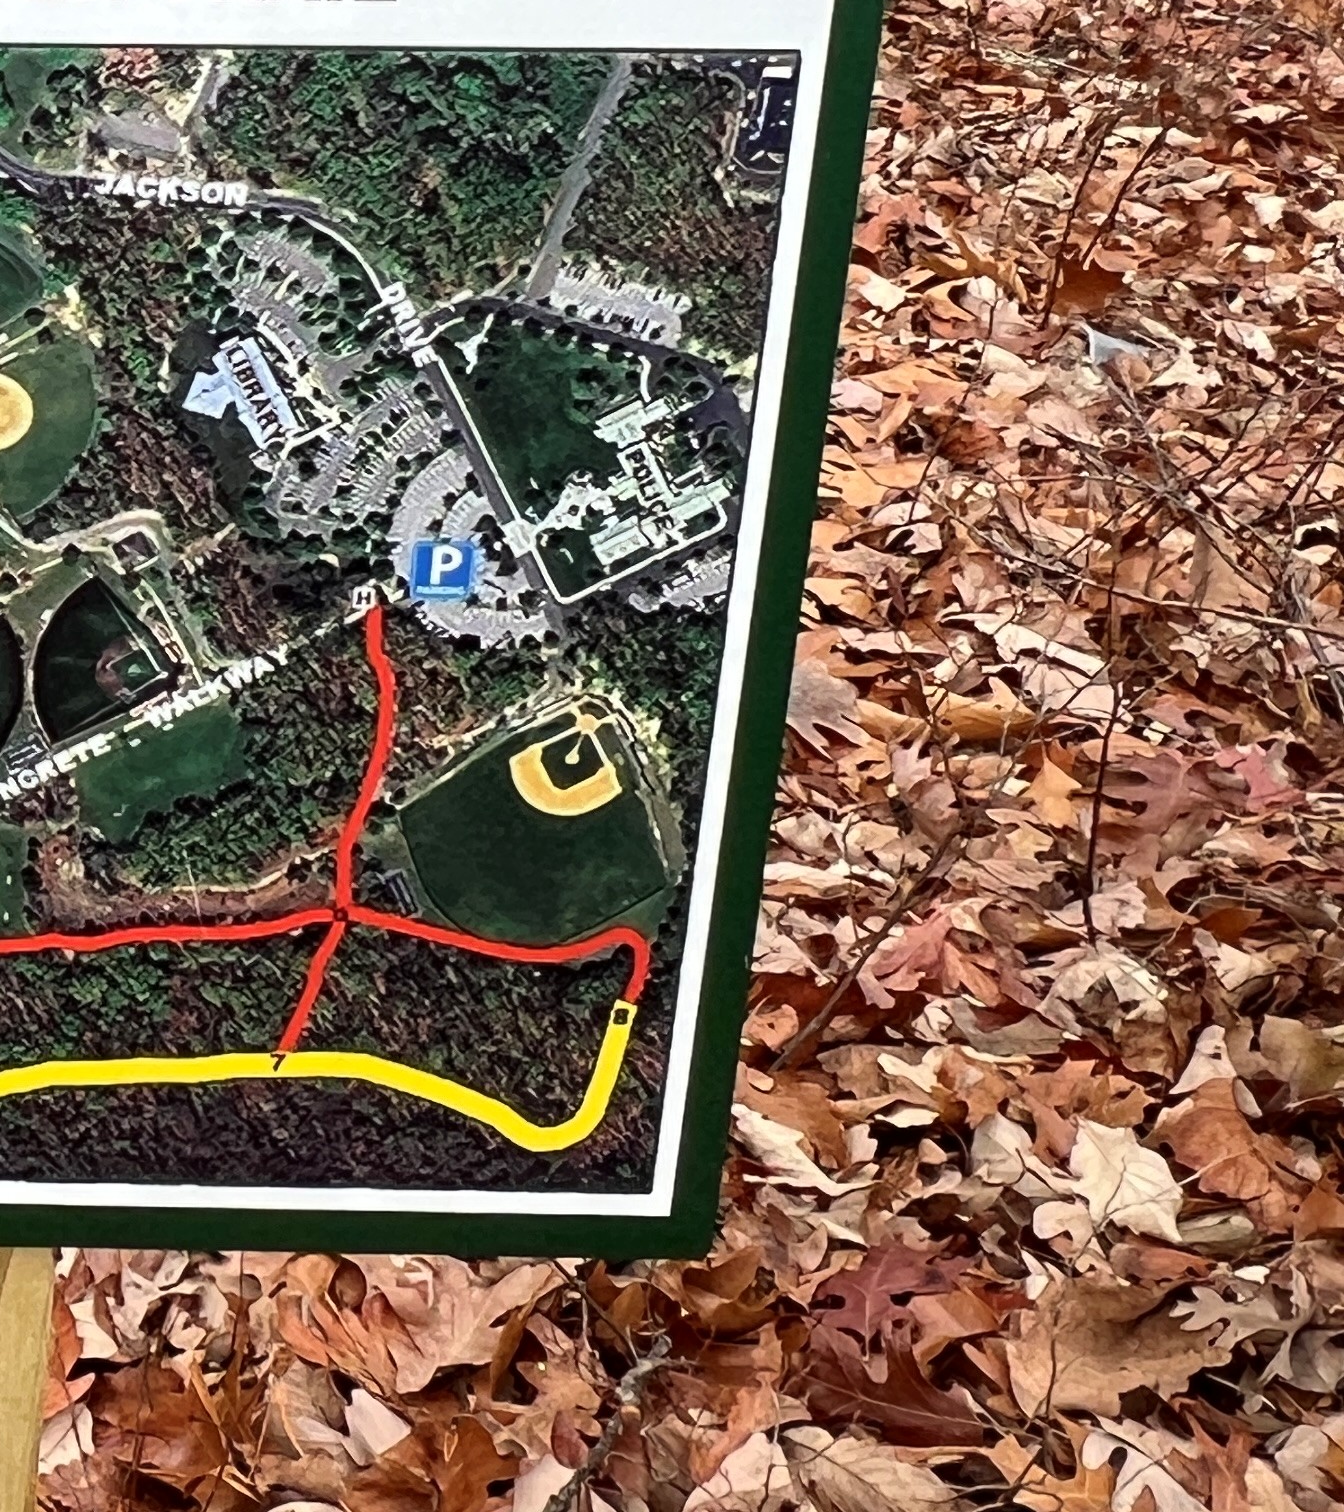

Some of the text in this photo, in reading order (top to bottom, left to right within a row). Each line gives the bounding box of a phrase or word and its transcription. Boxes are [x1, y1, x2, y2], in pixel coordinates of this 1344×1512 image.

[95, 175, 249, 207] JACKSON
[429, 544, 462, 585] P
[270, 1053, 287, 1071] 7
